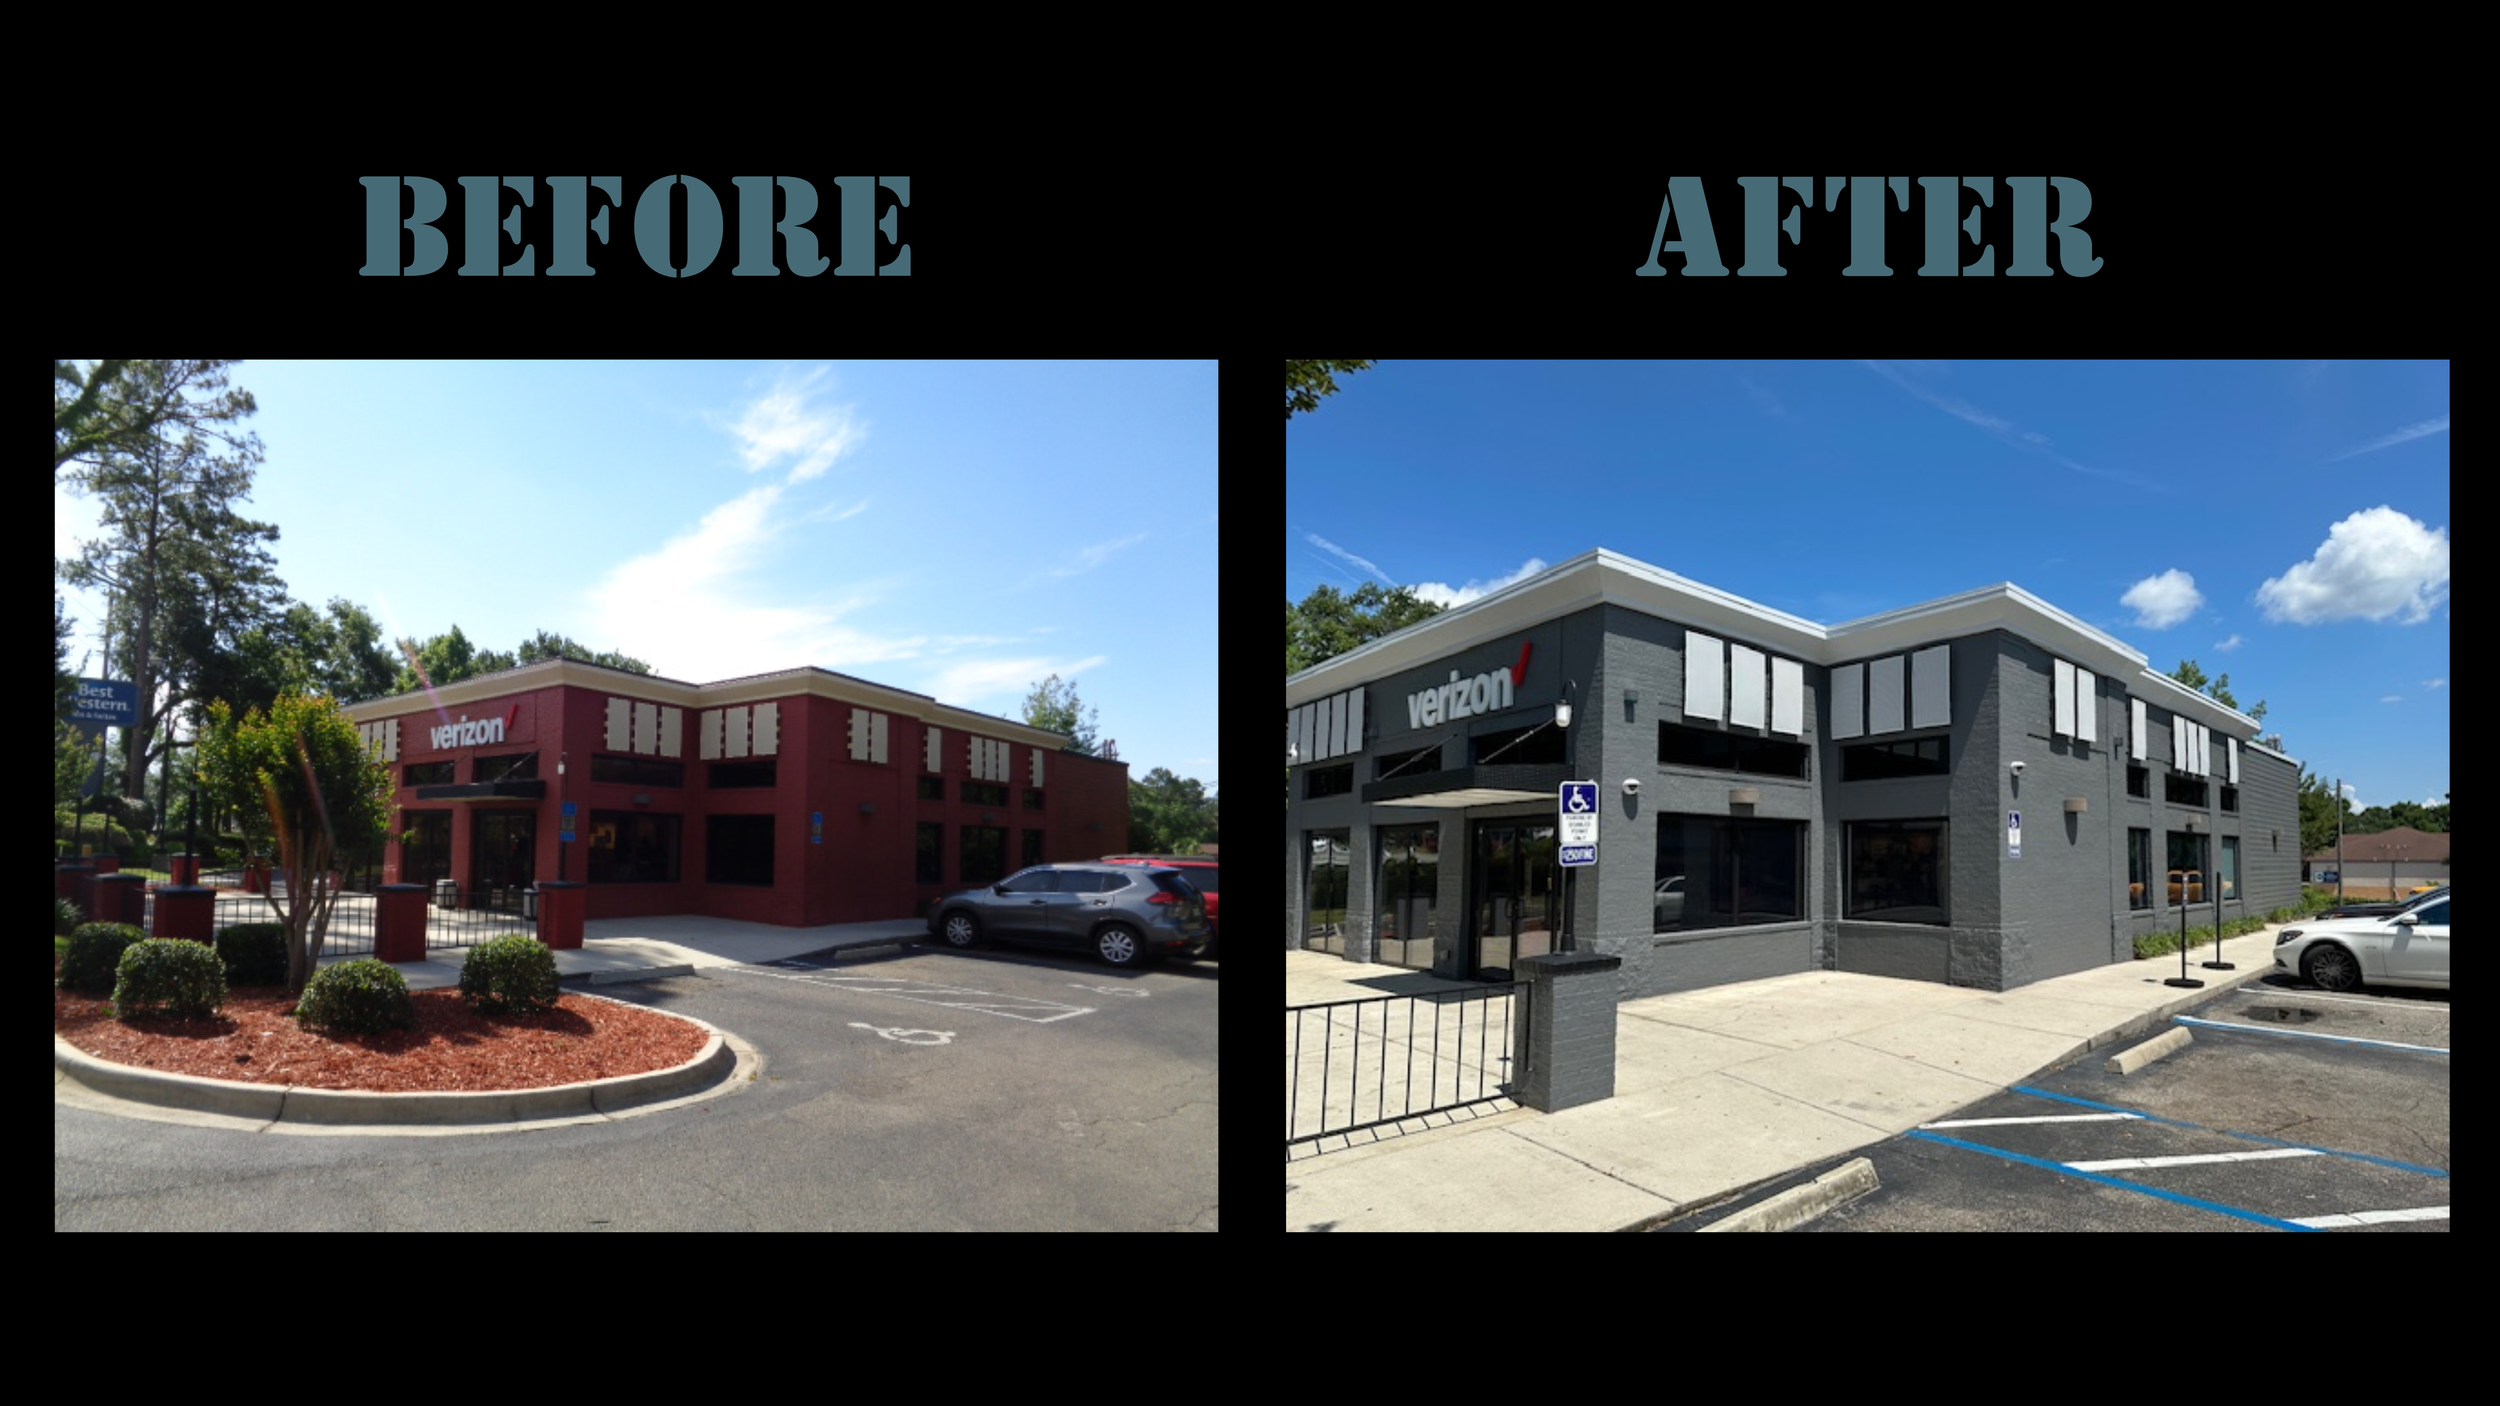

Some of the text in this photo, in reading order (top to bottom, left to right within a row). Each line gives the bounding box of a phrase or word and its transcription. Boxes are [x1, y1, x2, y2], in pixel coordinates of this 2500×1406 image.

[78, 684, 113, 698] Best
[1407, 667, 1514, 729] verizon
[67, 696, 127, 711] estern
[430, 715, 504, 749] verizon
